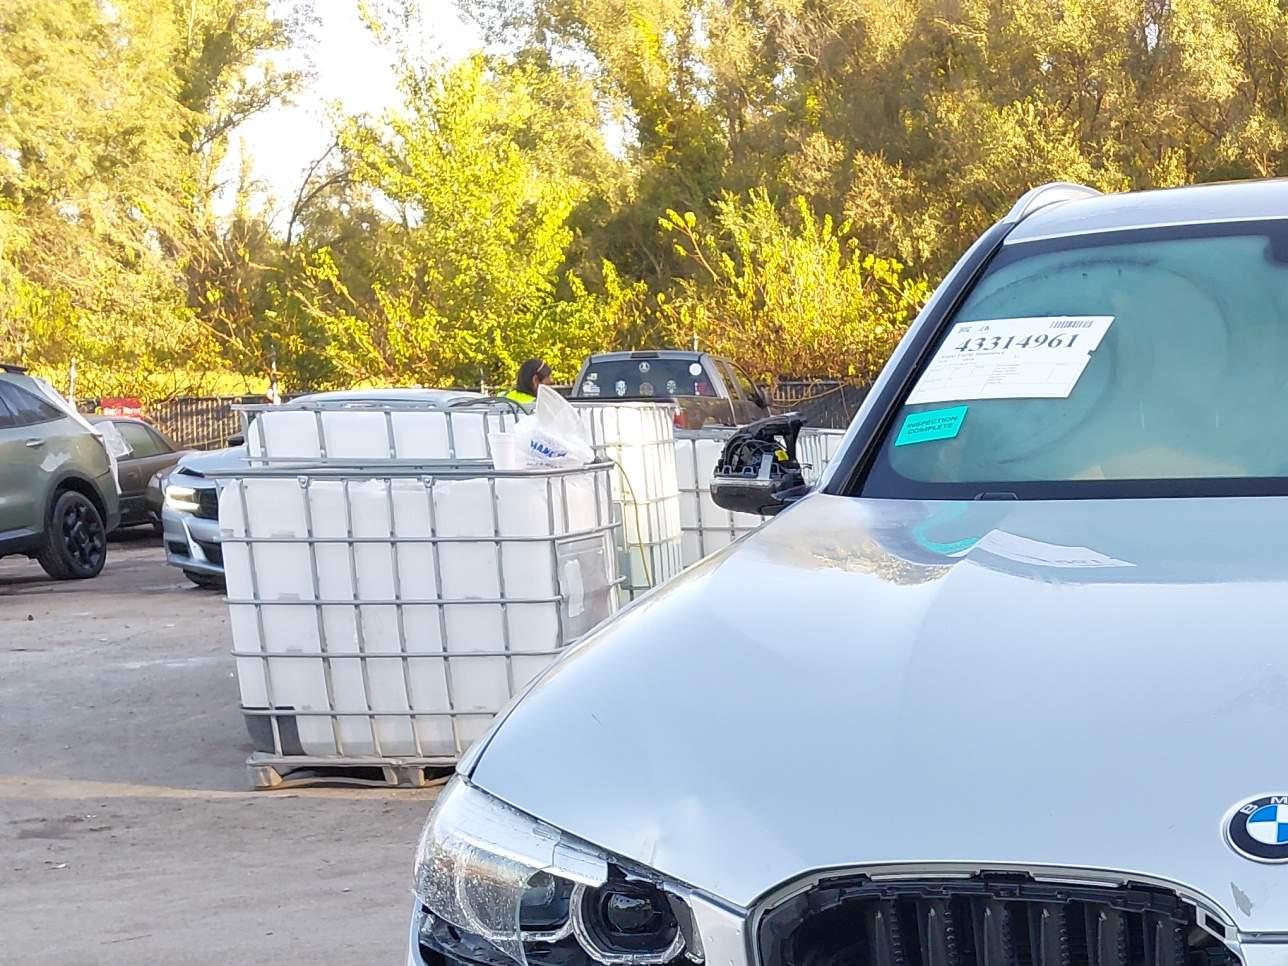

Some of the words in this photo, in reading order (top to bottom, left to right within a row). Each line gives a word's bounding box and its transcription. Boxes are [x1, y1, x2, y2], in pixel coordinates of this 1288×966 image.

[955, 332, 1080, 352] 43314961
[906, 416, 958, 428] INSPECTION
[907, 423, 953, 435] COMPLETE
